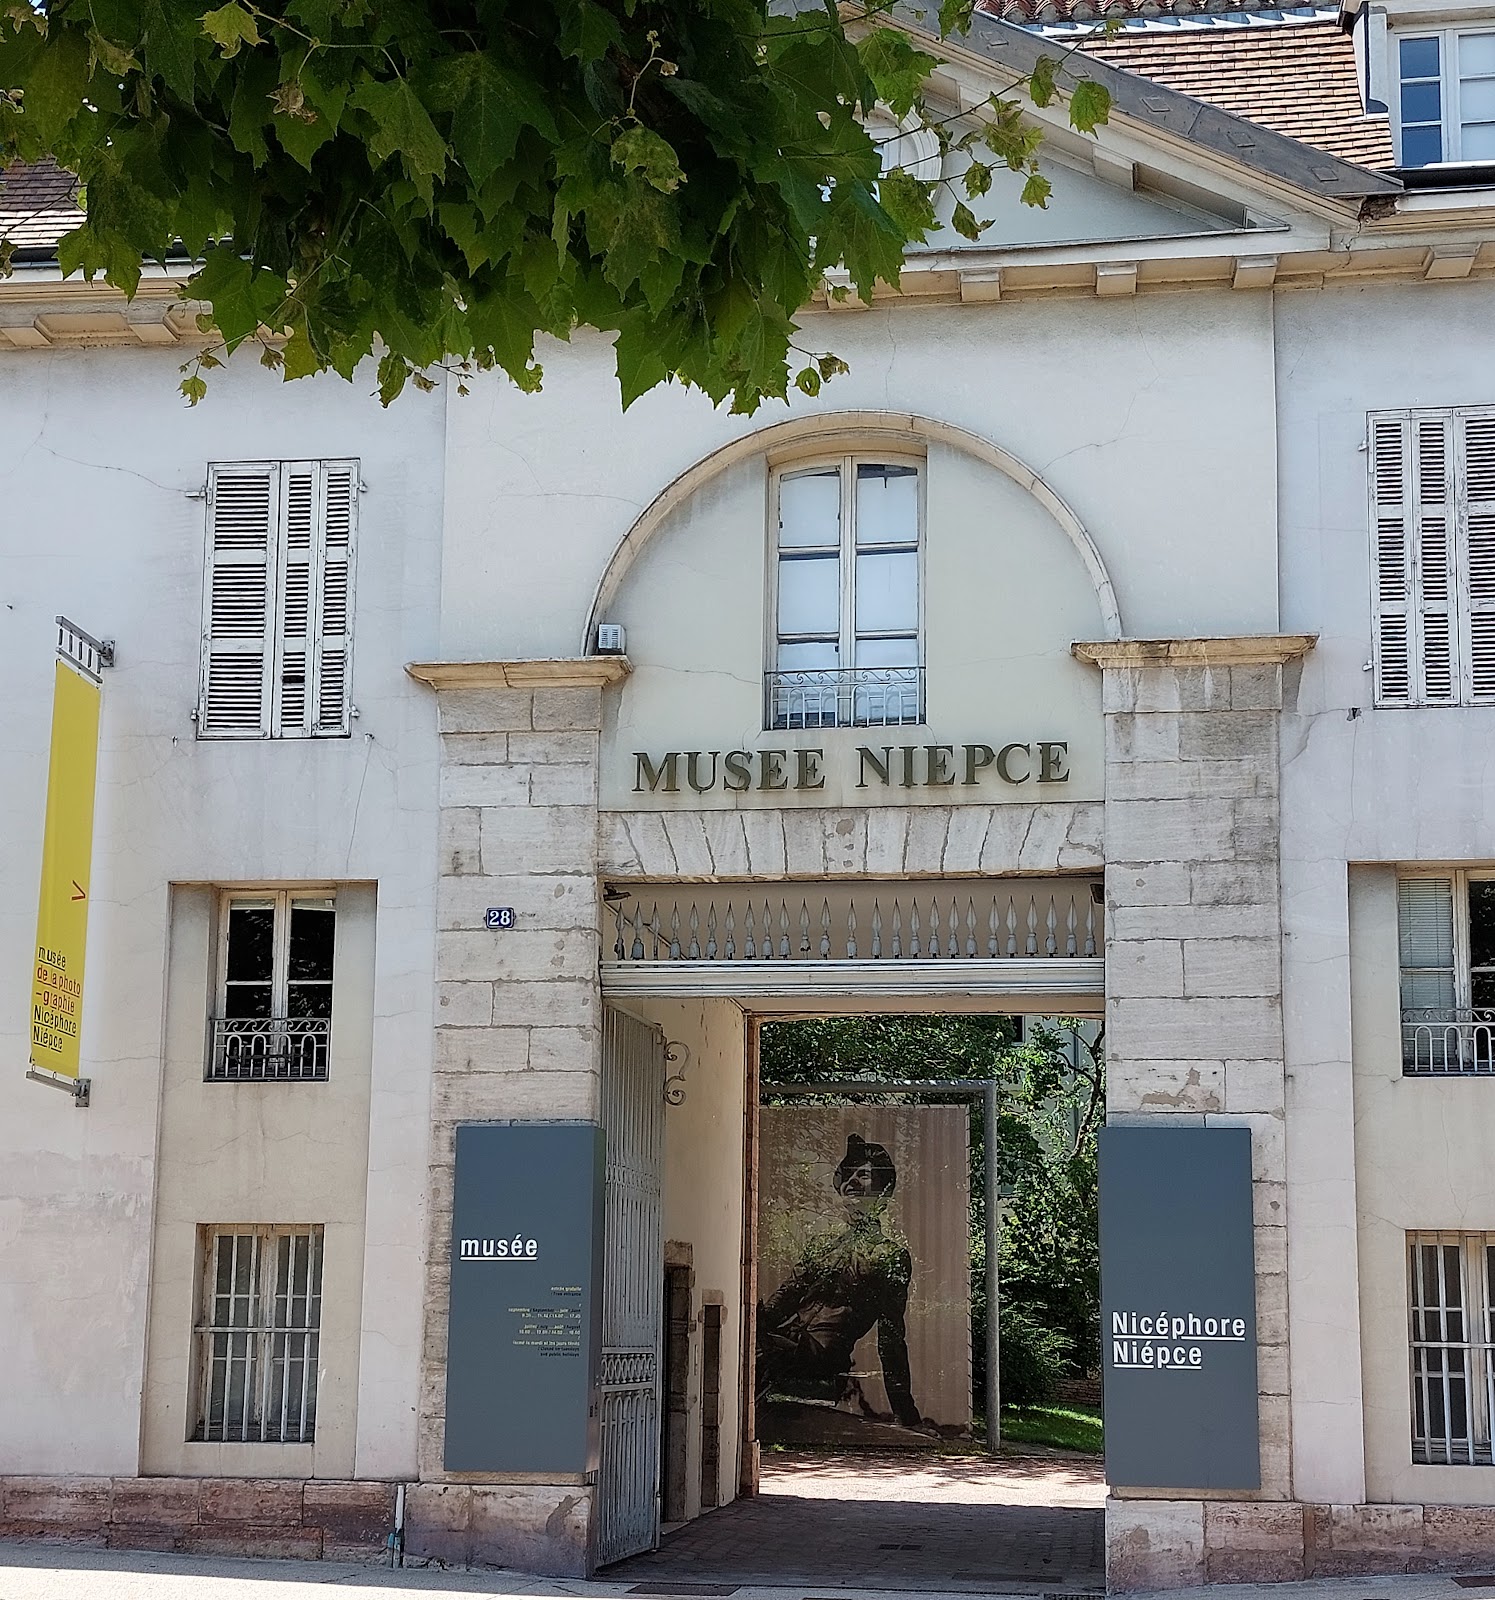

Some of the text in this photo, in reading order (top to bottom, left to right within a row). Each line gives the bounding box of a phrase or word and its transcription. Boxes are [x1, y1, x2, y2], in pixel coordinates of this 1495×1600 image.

[631, 741, 1071, 792] MUSEE NIEPCE
[489, 910, 511, 926] 28
[38, 946, 66, 968] musée
[36, 965, 48, 981] de
[59, 974, 81, 995] photo
[34, 1004, 77, 1034] Nicéphore
[33, 1026, 63, 1050] Niépce
[460, 1233, 538, 1258] musée
[1112, 1311, 1246, 1339] Nicéphore
[1113, 1340, 1202, 1369] Niépce
